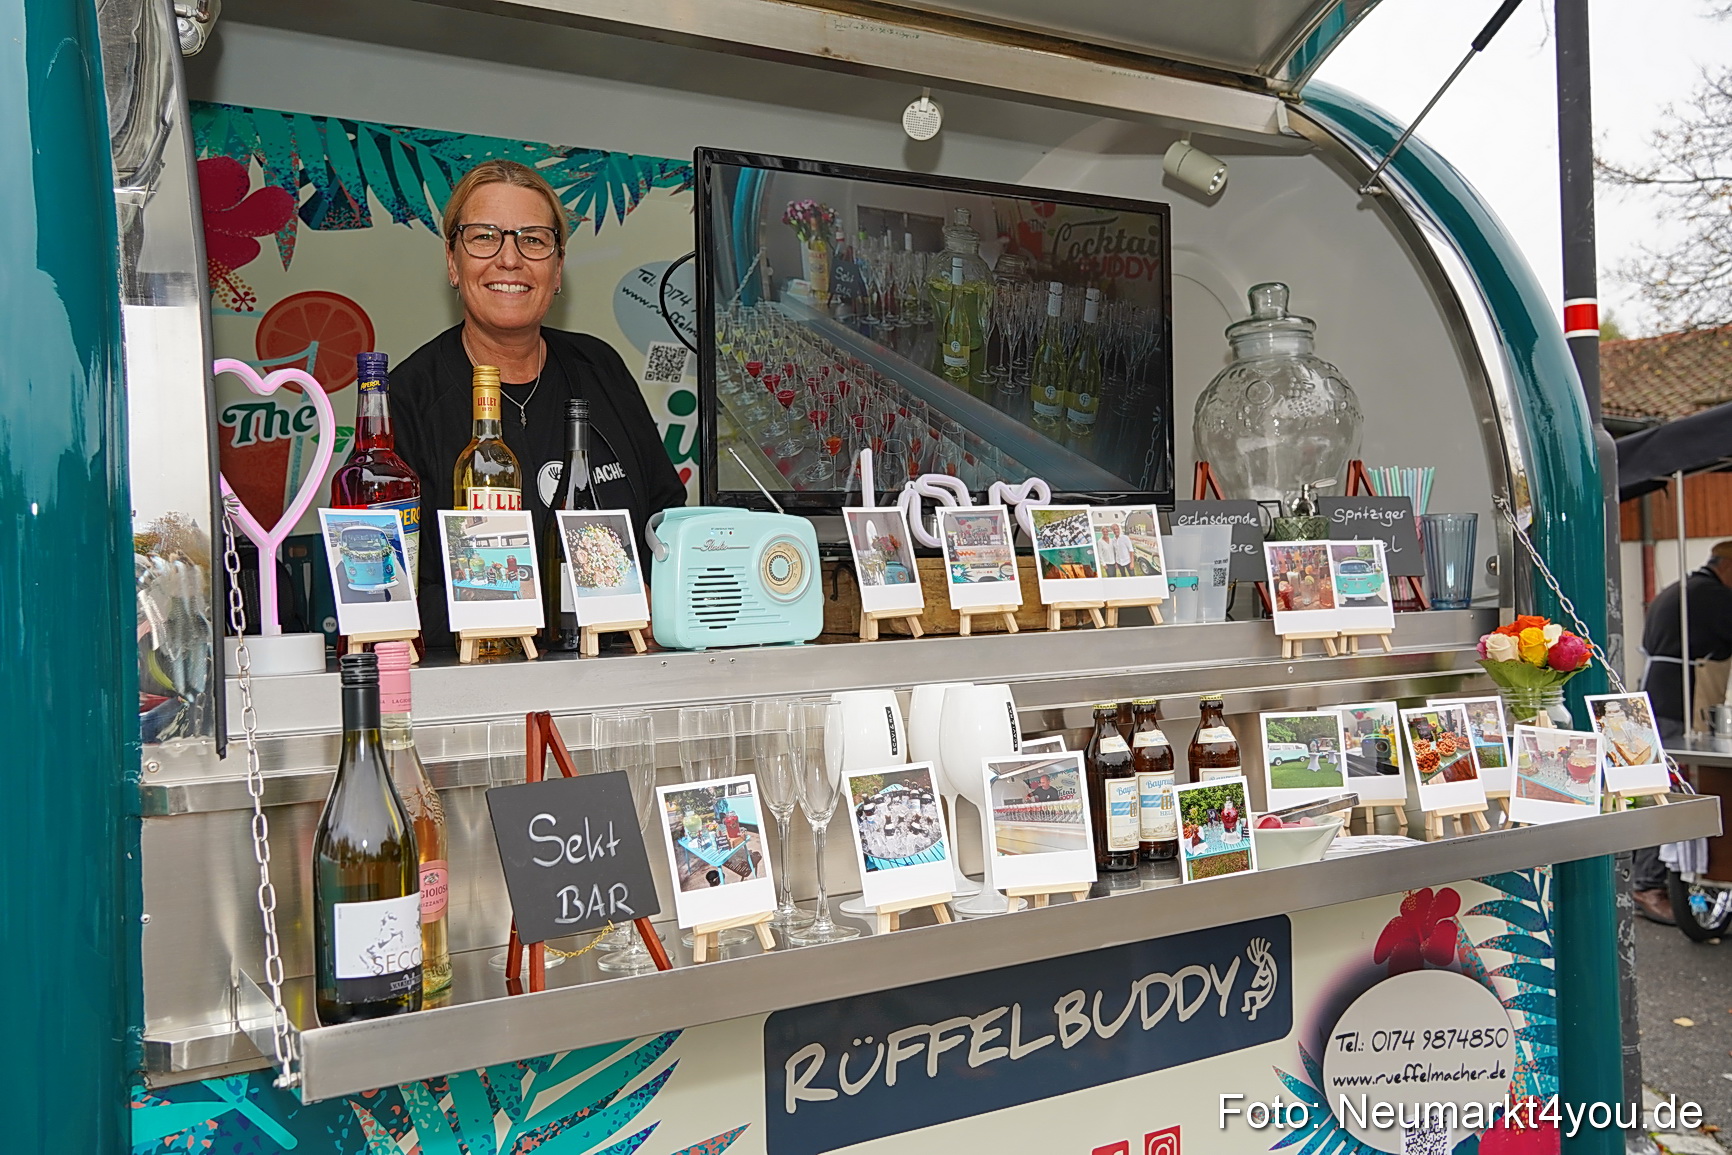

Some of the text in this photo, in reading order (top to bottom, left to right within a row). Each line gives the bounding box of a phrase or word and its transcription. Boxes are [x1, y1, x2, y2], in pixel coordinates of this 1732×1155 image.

[222, 401, 317, 444] The
[1331, 506, 1407, 527] Spritziger
[528, 813, 621, 867] Sekt
[554, 882, 635, 924] BAR
[372, 944, 424, 976] SECC
[785, 956, 1241, 1114] RÜFFELBUDDY
[1335, 1027, 1509, 1053] Tel.: 0174 9874850
[1332, 1059, 1507, 1087] www.rueffelmacher.de
